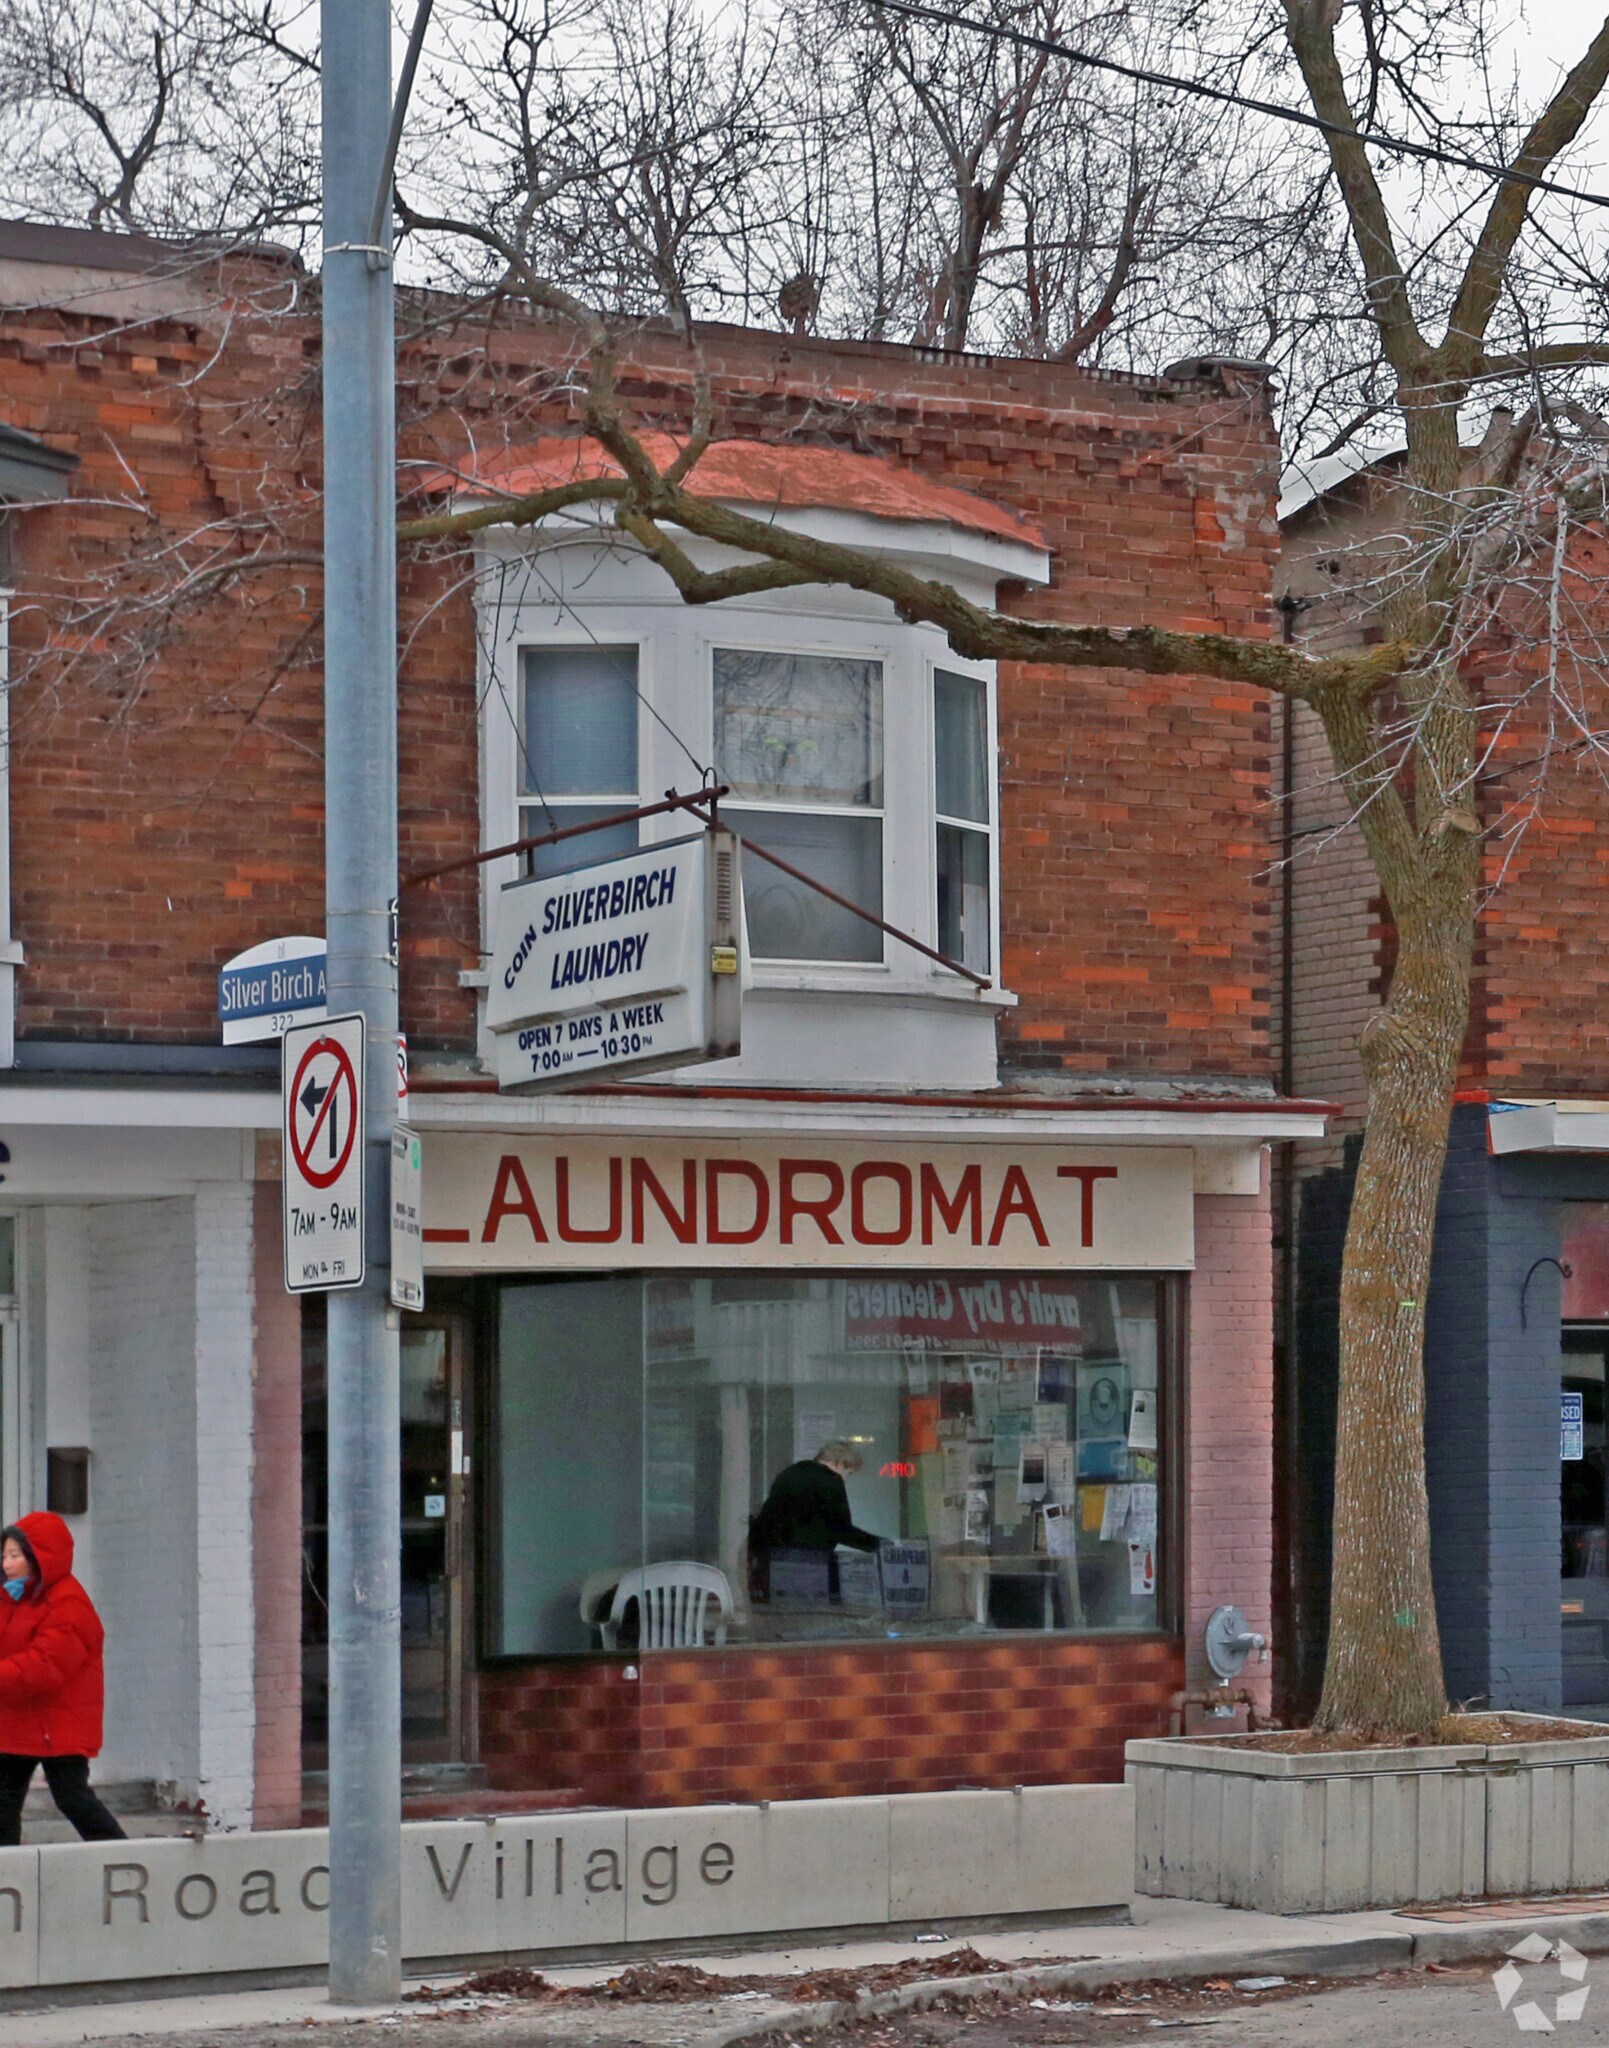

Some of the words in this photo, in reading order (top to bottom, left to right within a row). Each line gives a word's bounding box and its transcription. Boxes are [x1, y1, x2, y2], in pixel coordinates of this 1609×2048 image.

[542, 866, 677, 935] SILVERBIRCH
[504, 924, 537, 990] COIN
[550, 932, 649, 990] LAUNDRY
[222, 976, 267, 1011] Silver
[271, 966, 313, 1003] Birch
[518, 1026, 551, 1051] OPEN
[555, 1023, 563, 1044] 7
[569, 1016, 602, 1041] DAYS
[609, 1012, 619, 1033] A
[622, 1003, 664, 1030] WEEK
[291, 1207, 315, 1236] 7AM
[330, 1202, 357, 1231] 9AM
[302, 1263, 319, 1280] MON
[333, 1260, 346, 1277] FRI
[425, 1837, 736, 1907] Village
